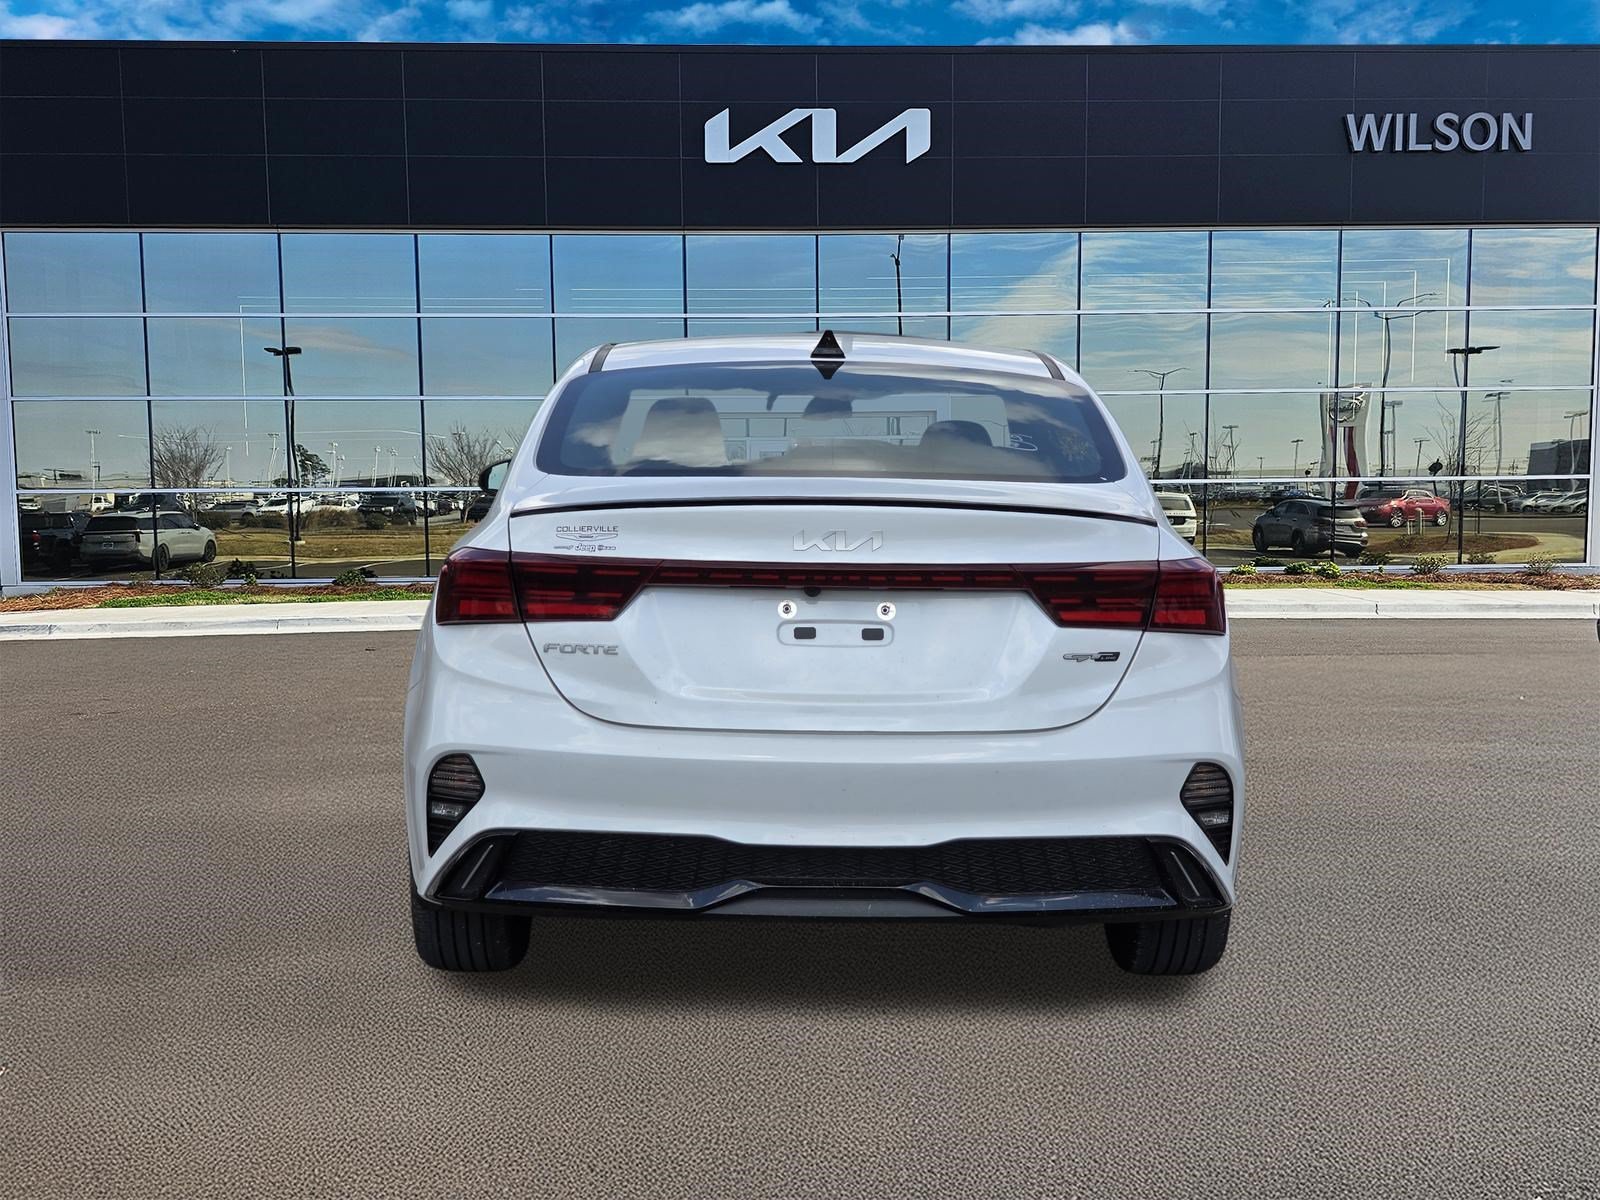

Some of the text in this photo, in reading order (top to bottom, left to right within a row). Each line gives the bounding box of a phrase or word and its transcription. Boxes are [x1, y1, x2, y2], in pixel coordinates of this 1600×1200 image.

[704, 107, 931, 164] KIA
[1346, 111, 1533, 151] WILSON
[575, 543, 596, 552] Jeep
[543, 643, 619, 655] FORTE
